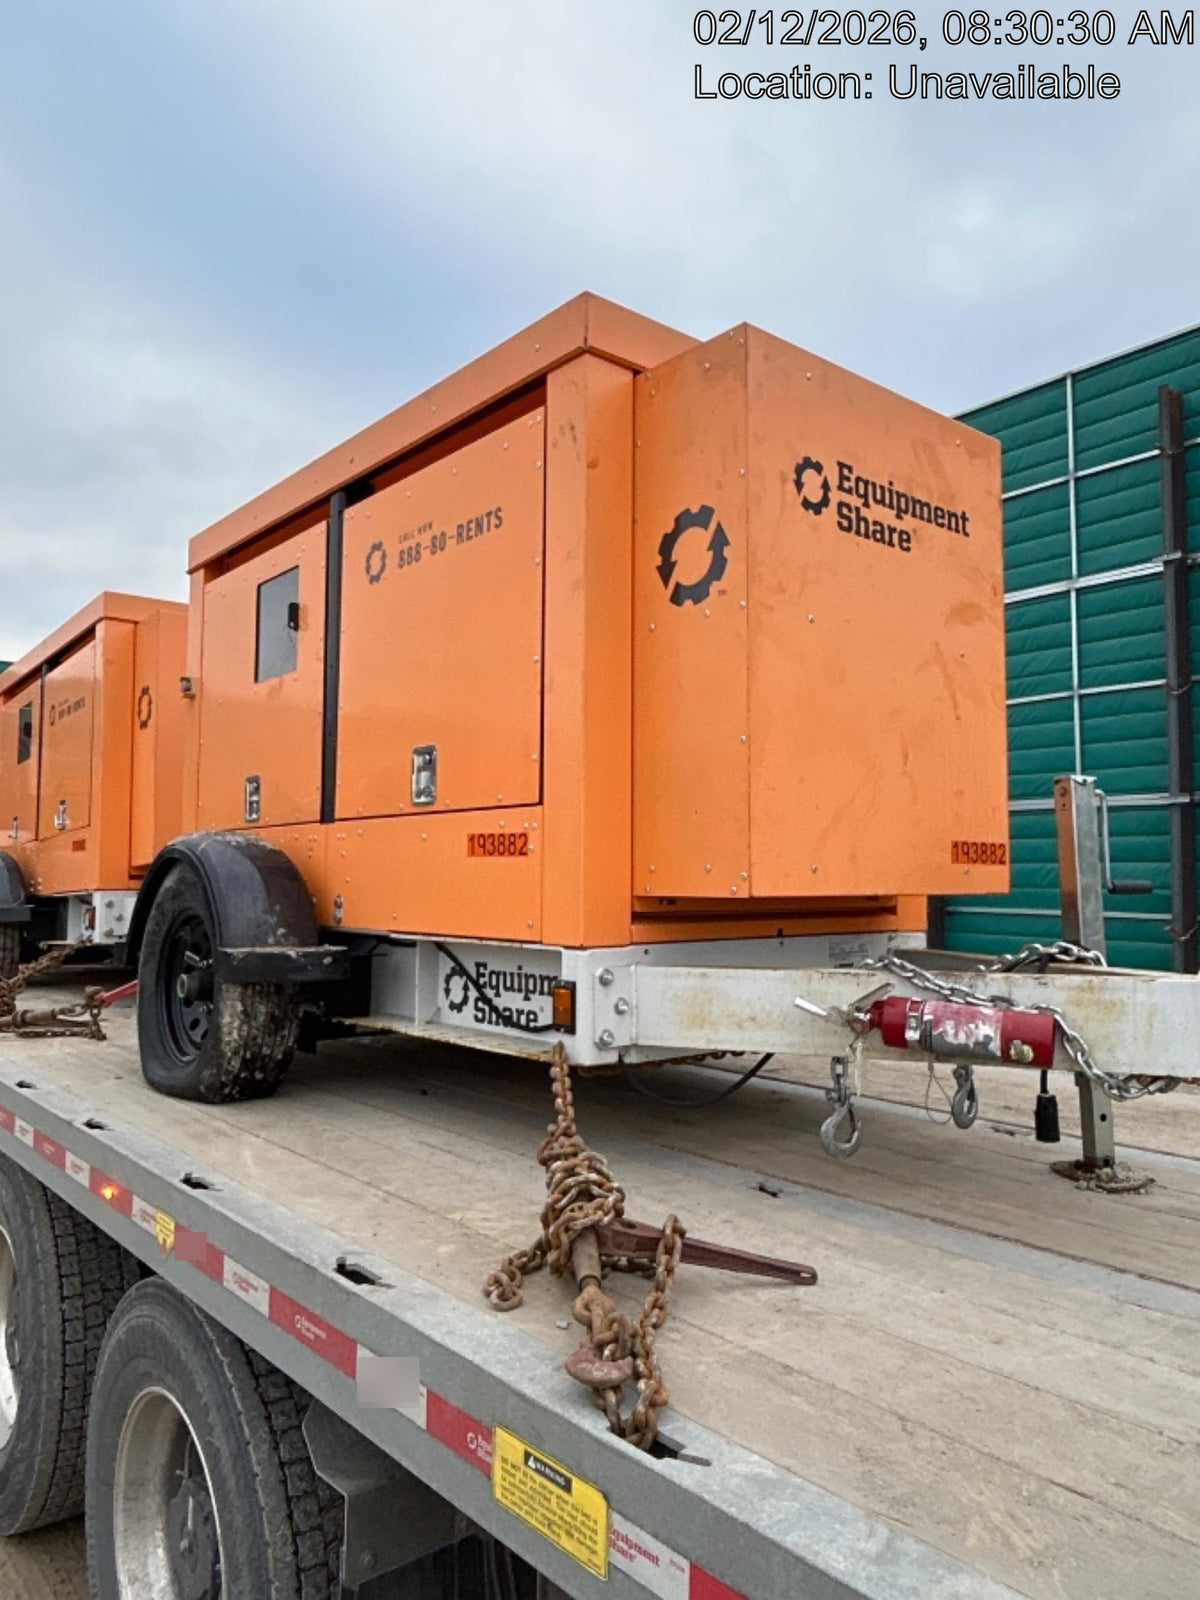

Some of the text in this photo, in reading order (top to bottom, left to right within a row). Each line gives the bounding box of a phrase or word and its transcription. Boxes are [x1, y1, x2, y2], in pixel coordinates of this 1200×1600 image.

[836, 460, 970, 537] Equipment
[397, 507, 503, 569] 888-80-RENTS
[836, 500, 912, 552] Share
[468, 833, 529, 856] 193882
[952, 841, 1006, 865] 193882
[474, 960, 559, 1001] Equipm
[473, 996, 539, 1029] Share
